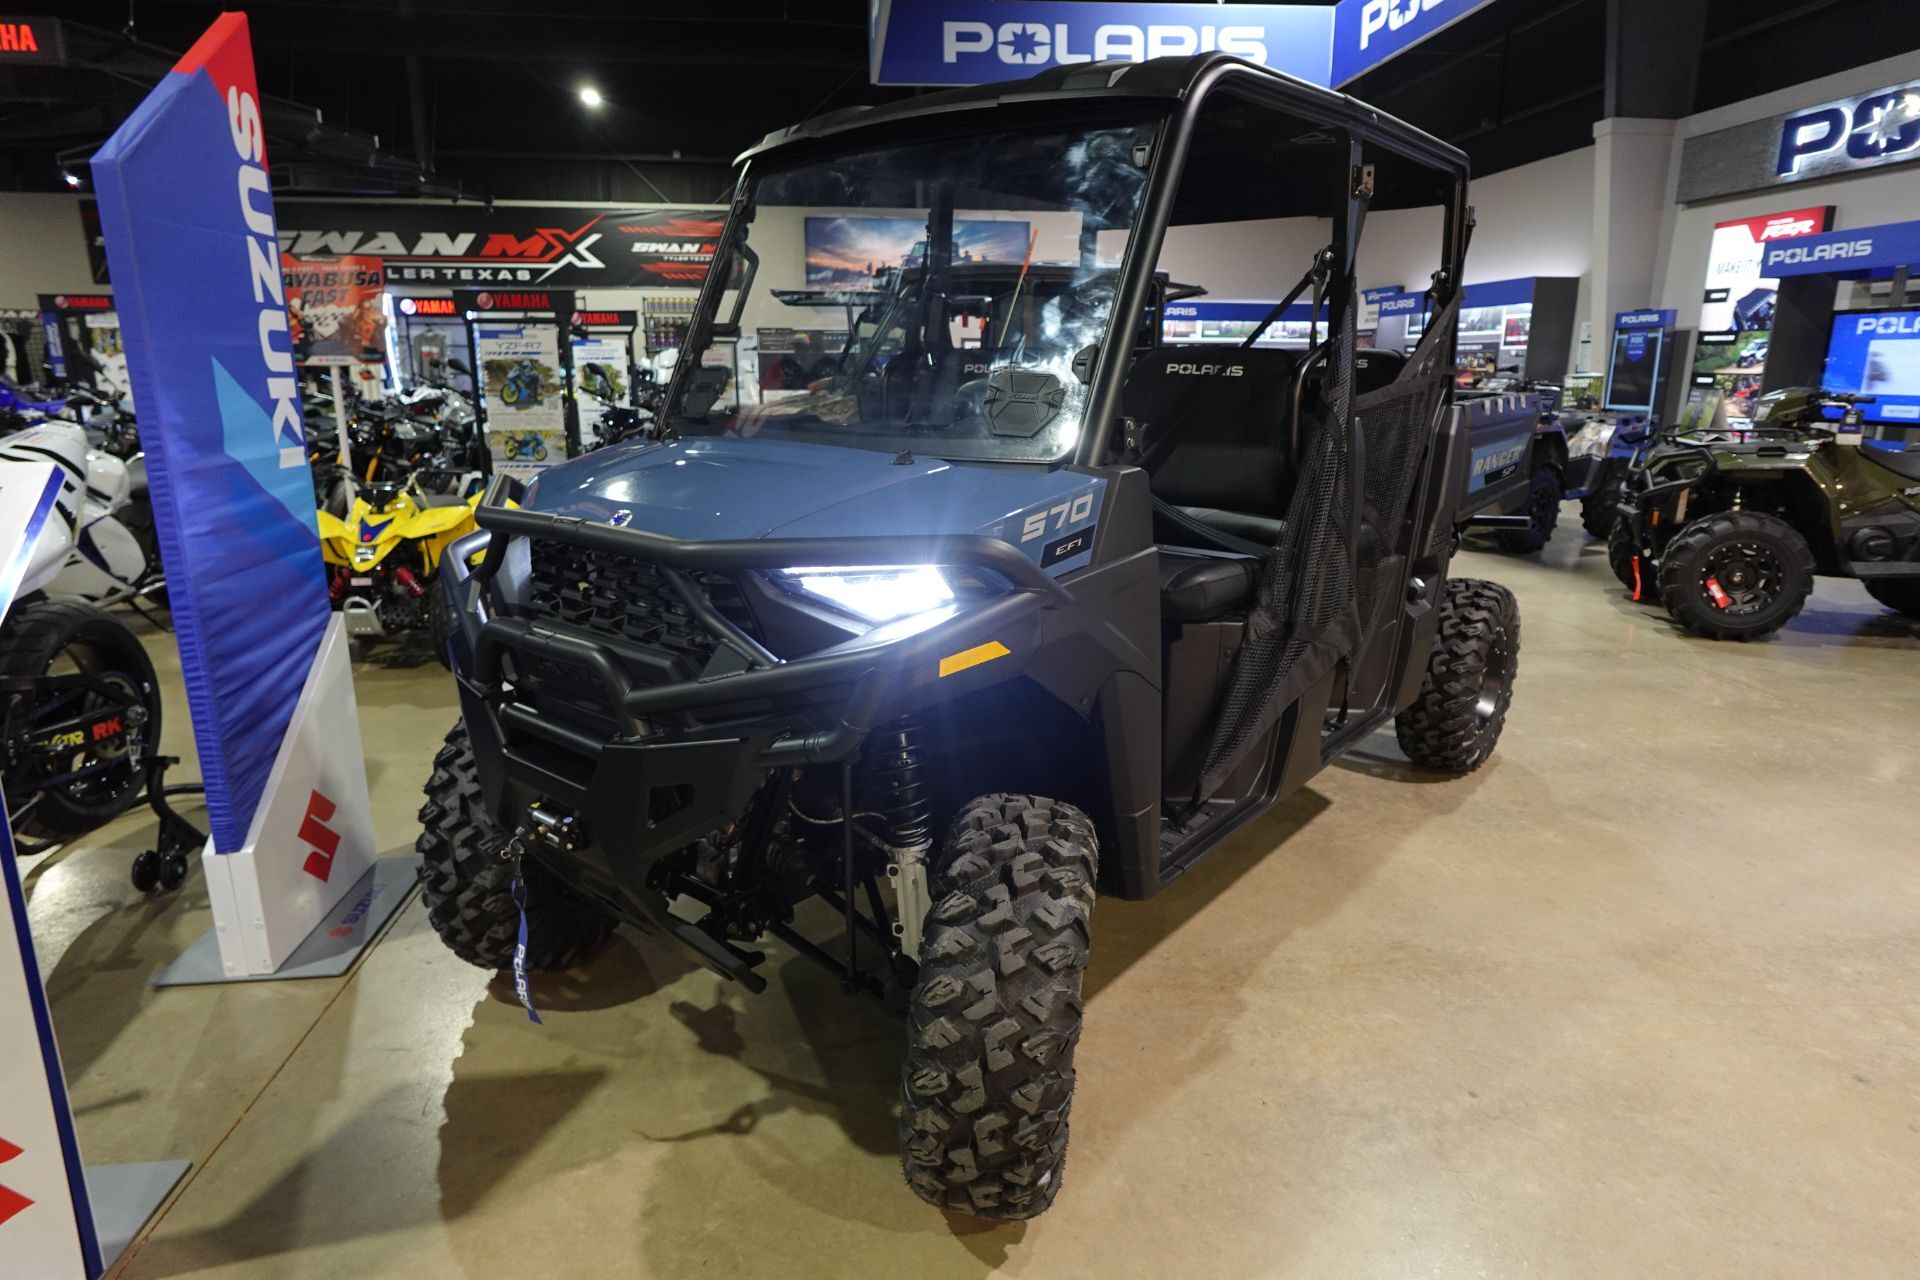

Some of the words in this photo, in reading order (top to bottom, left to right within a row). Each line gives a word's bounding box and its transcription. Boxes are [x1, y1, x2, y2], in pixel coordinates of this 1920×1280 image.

[943, 21, 1268, 66] POLARIS
[277, 230, 477, 256] WAN
[631, 242, 700, 253] SWAN
[1767, 239, 1873, 266] POLARIS
[227, 85, 306, 470] SUZUKI
[283, 271, 381, 288] AYABUSA
[386, 268, 436, 279] LER
[442, 269, 531, 280] TEXAS
[414, 300, 455, 314] YAMAH
[492, 293, 550, 309] YAMAHA
[582, 313, 620, 325] YAMAHA
[1165, 307, 1197, 316] ARIS
[1021, 493, 1094, 543] 570
[1055, 537, 1082, 556] EFI
[93, 717, 122, 741] RK
